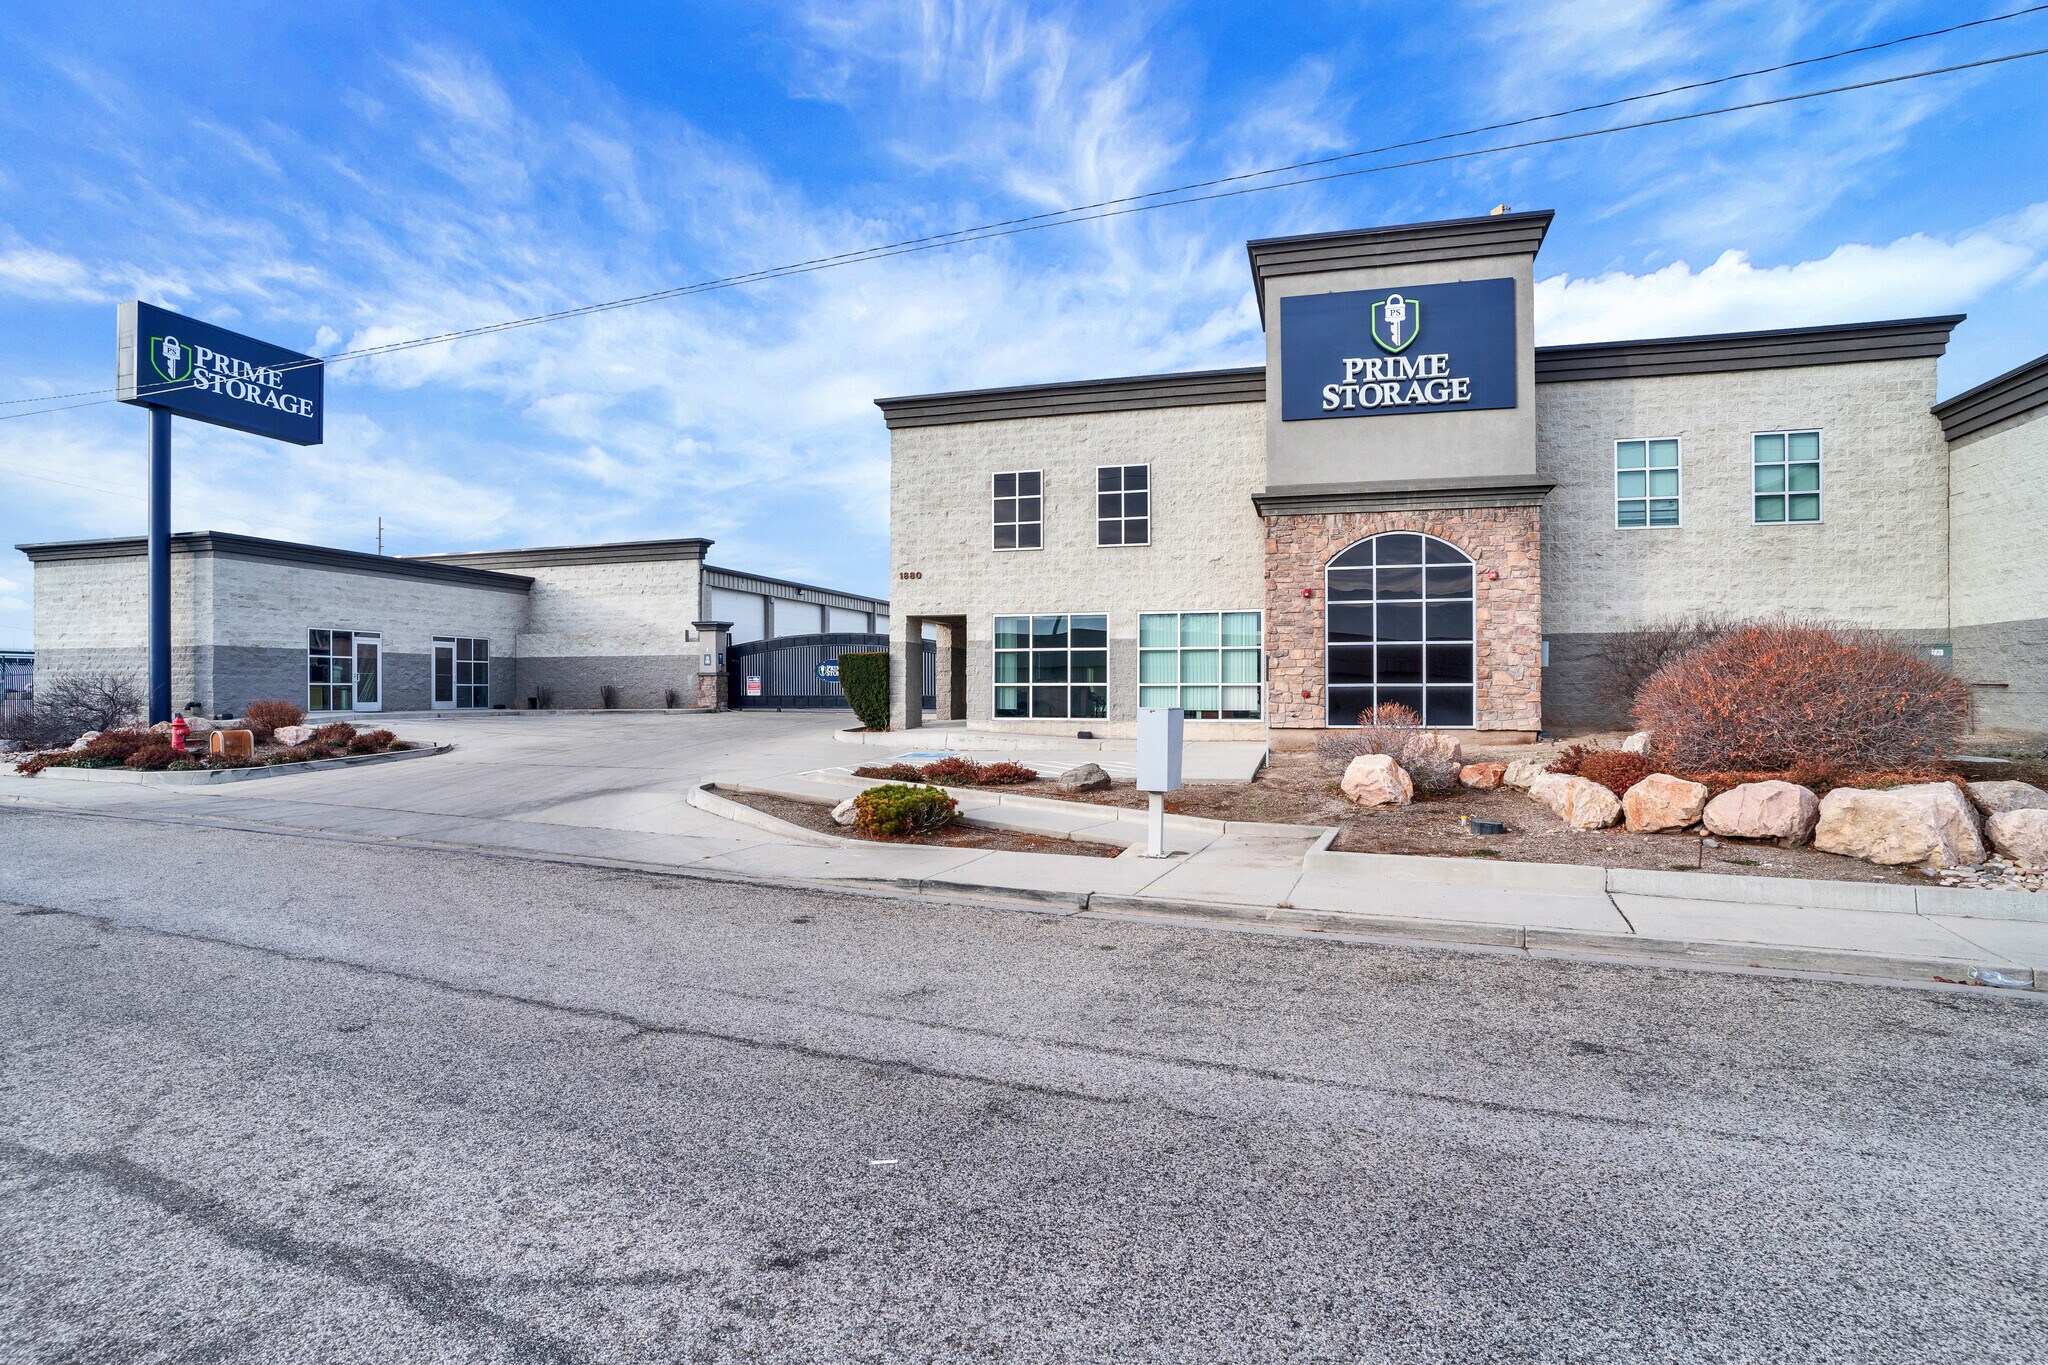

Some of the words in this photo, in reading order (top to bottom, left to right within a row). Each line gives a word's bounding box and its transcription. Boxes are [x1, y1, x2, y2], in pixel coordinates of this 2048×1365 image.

[1390, 308, 1401, 317] PS
[194, 344, 283, 390] PRIME
[1343, 353, 1450, 384] PRIME
[193, 367, 314, 418] STORAGE
[1322, 377, 1472, 411] STORAGE
[899, 571, 923, 580] 1880
